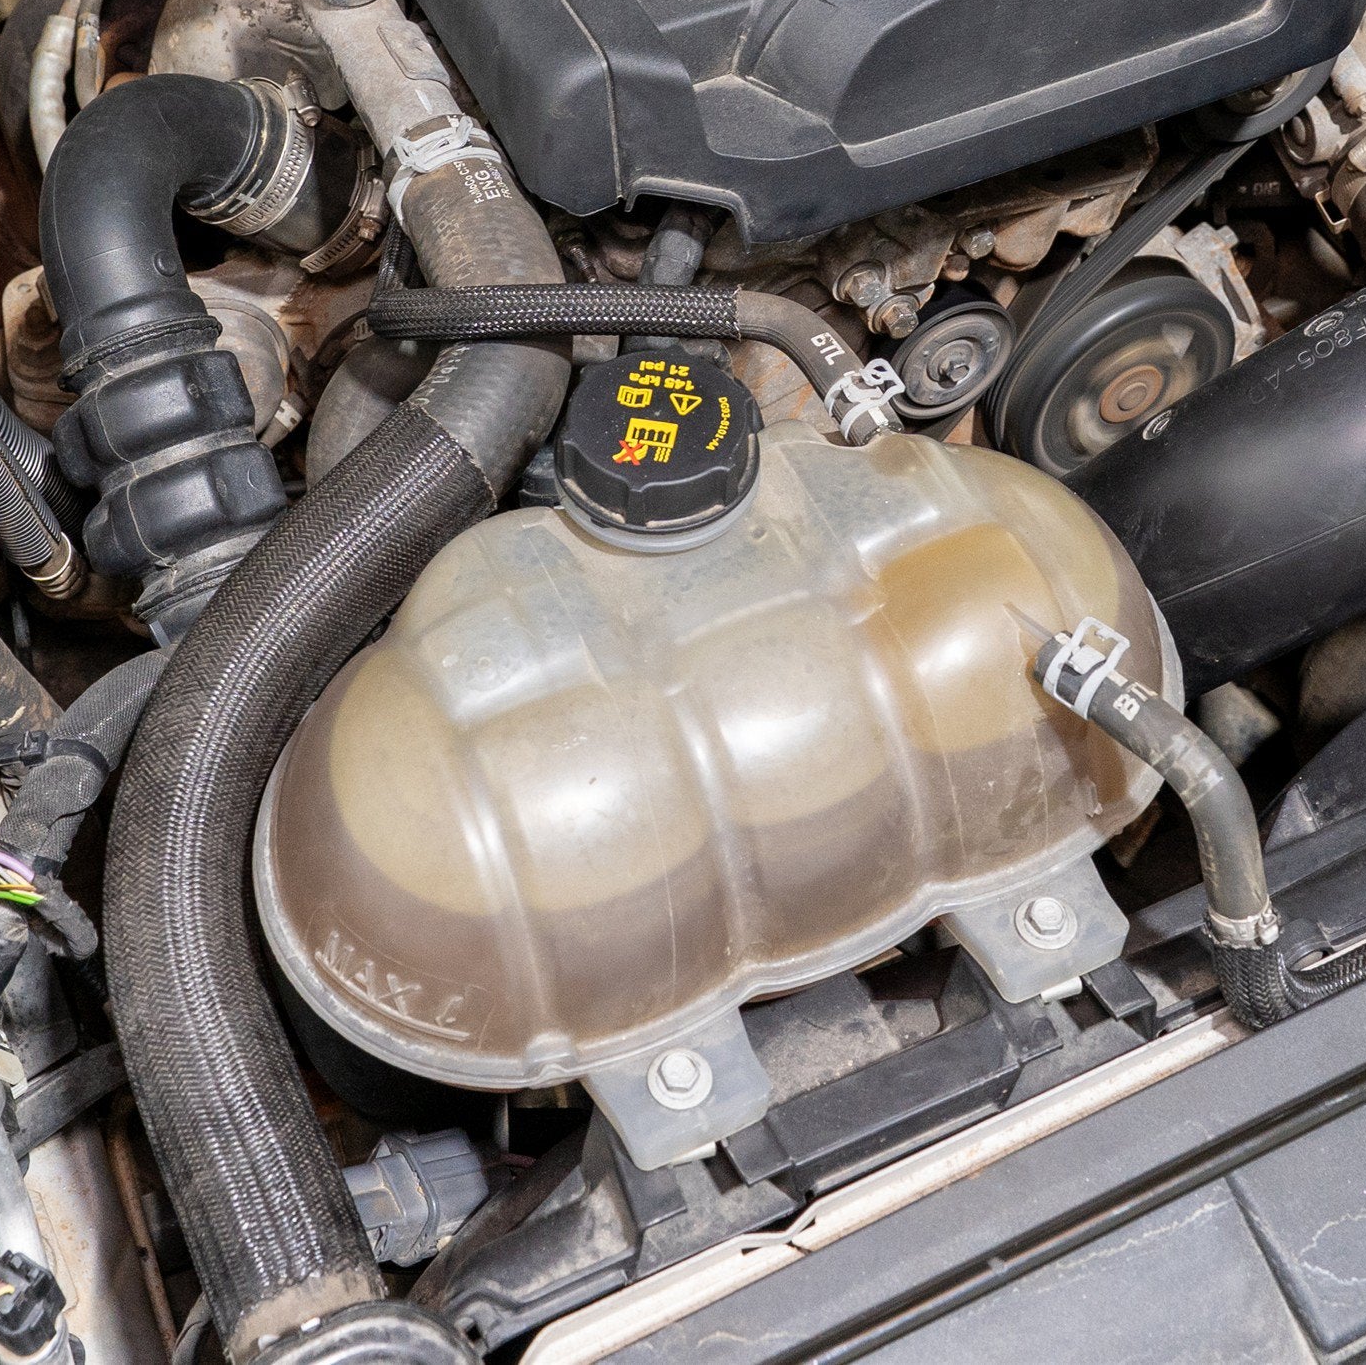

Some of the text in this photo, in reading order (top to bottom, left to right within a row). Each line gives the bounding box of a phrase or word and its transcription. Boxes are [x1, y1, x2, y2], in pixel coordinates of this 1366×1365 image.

[475, 169, 502, 201] ENG
[810, 332, 846, 366] BTL
[629, 372, 695, 392] 145 kPa
[639, 360, 690, 377] 21 psi
[322, 929, 423, 1017] MAX
